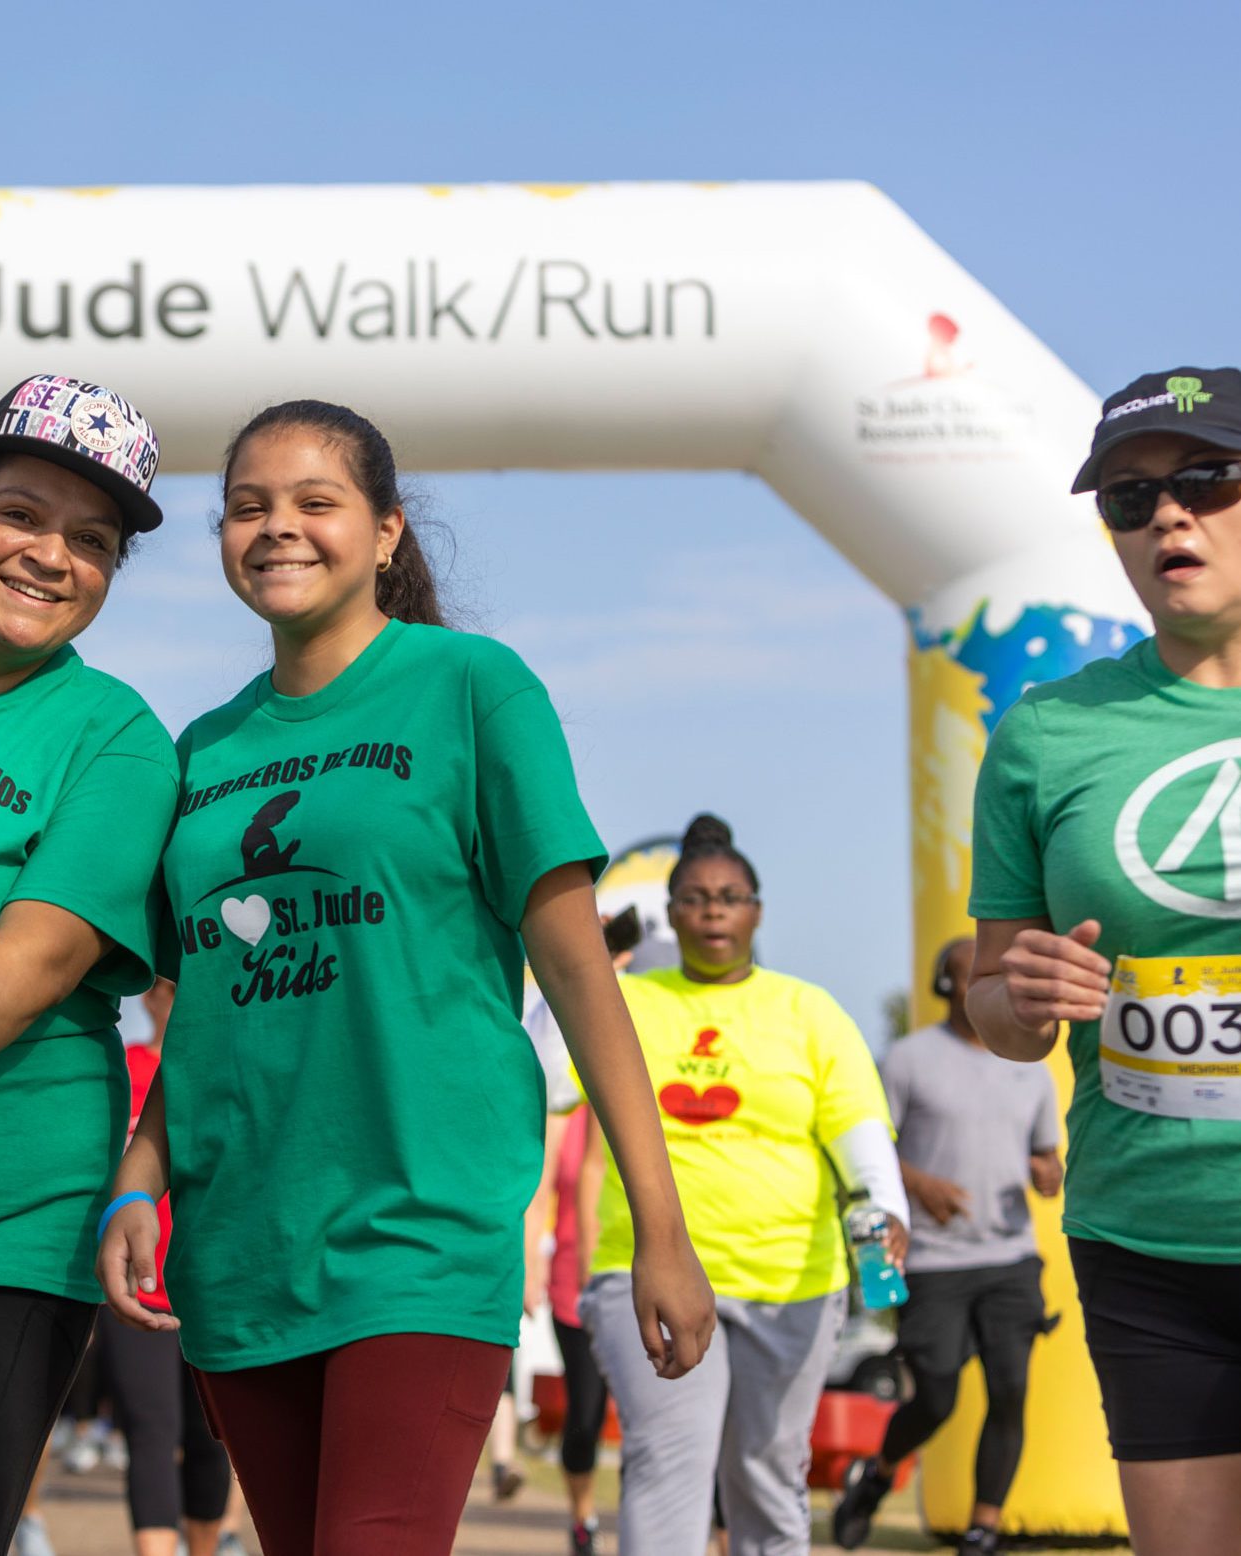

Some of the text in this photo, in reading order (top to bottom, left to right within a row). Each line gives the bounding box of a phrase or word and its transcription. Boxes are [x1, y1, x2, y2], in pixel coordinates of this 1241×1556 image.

[247, 257, 716, 340] Walk/Run
[77, 426, 111, 448] ALL STAR
[83, 403, 121, 429] CONVERSE
[180, 742, 413, 818] UERREROS DE DIOS
[272, 897, 308, 936] St.
[313, 885, 385, 929] Jude
[231, 941, 339, 1008] Kids
[1120, 1002, 1241, 1055] 003
